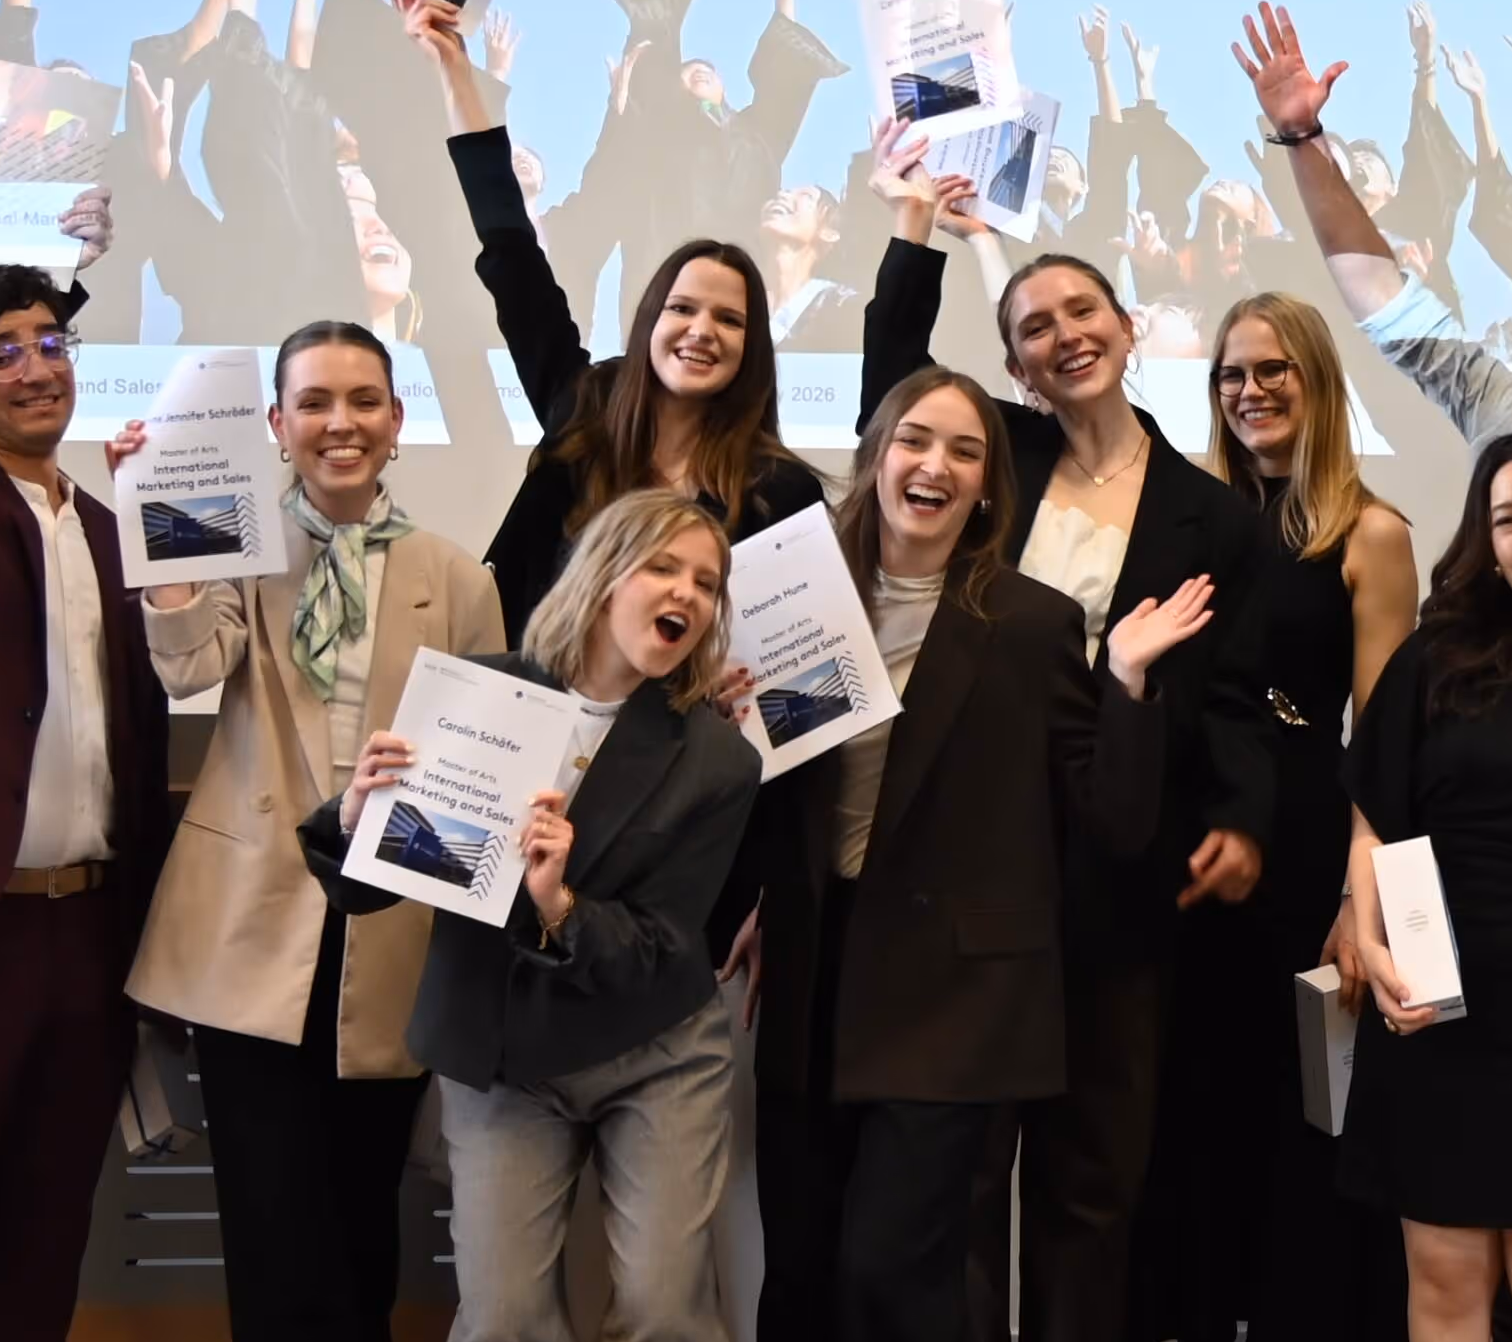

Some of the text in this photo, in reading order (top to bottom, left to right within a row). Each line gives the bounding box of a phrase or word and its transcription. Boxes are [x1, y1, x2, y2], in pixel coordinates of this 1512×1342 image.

[75, 379, 107, 395] and
[791, 386, 836, 403] 2026
[165, 409, 206, 424] Jennifer
[208, 405, 256, 420] Schröder
[160, 448, 188, 458] Master
[154, 459, 229, 475] International
[136, 473, 252, 492] Marketing and Sales
[741, 594, 782, 619] Deborah
[759, 626, 825, 664] International
[800, 645, 820, 662] and
[820, 633, 847, 652] Sales
[437, 717, 522, 754] Carolin Schäfer
[437, 757, 467, 774] Master
[478, 771, 497, 785] Arts
[423, 770, 502, 804] International
[399, 778, 515, 827] Marketing and Sales
